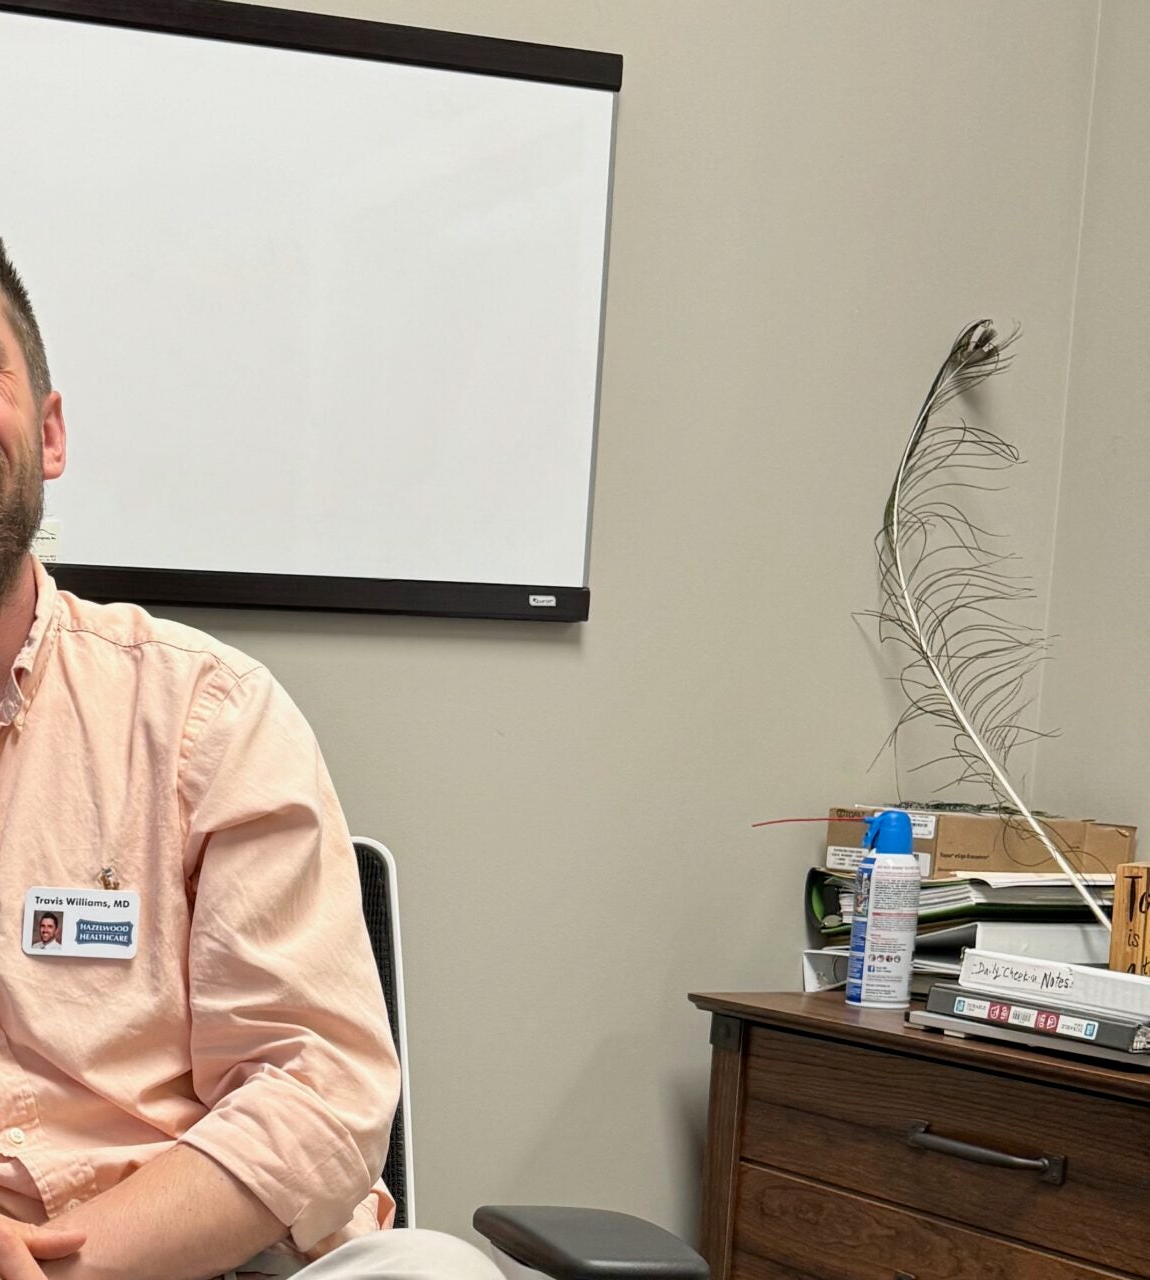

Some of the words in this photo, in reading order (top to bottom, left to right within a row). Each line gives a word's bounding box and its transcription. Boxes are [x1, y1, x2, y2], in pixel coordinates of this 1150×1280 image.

[35, 896, 63, 906] Travis
[66, 898, 111, 909] Williams,
[113, 900, 130, 909] MD
[80, 923, 129, 932] HAZELWOOD
[79, 933, 129, 943] HEALTHCARE
[1127, 928, 1140, 947] is
